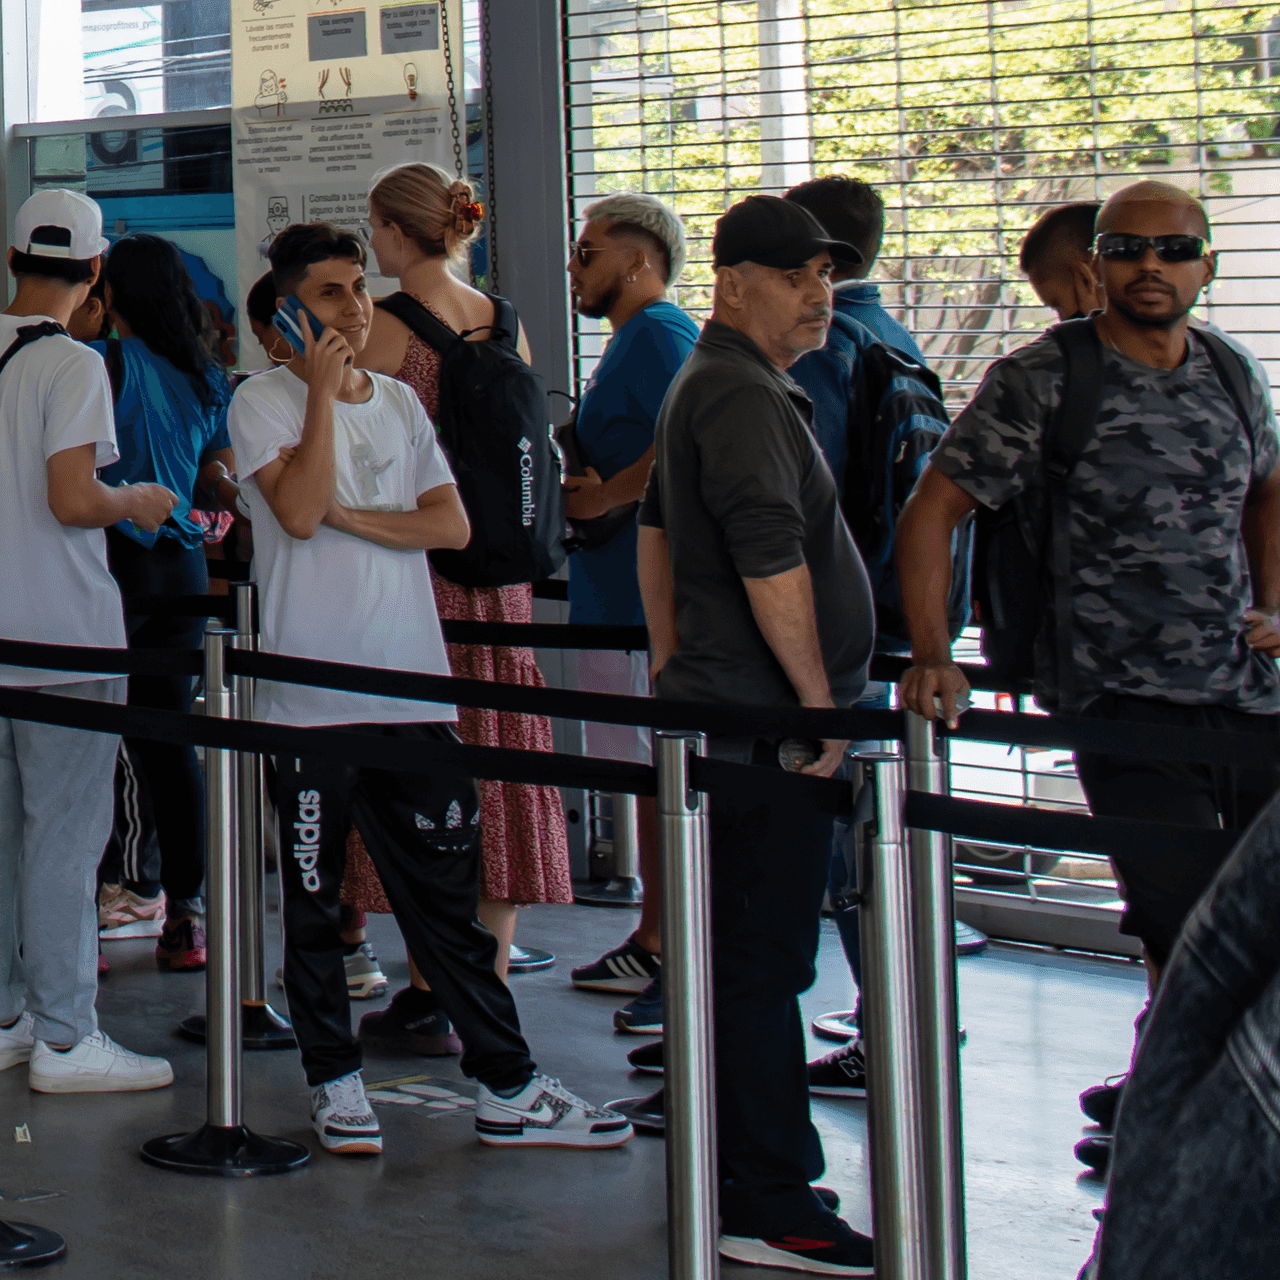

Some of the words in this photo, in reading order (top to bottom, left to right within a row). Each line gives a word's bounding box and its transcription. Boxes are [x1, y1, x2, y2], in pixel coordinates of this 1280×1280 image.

[309, 193, 340, 202] Consulta
[348, 193, 355, 201] tu
[309, 206, 333, 216] alguno
[335, 205, 344, 214] de
[345, 205, 356, 213] los
[520, 454, 535, 527] Columbia
[293, 789, 321, 892] adidas
